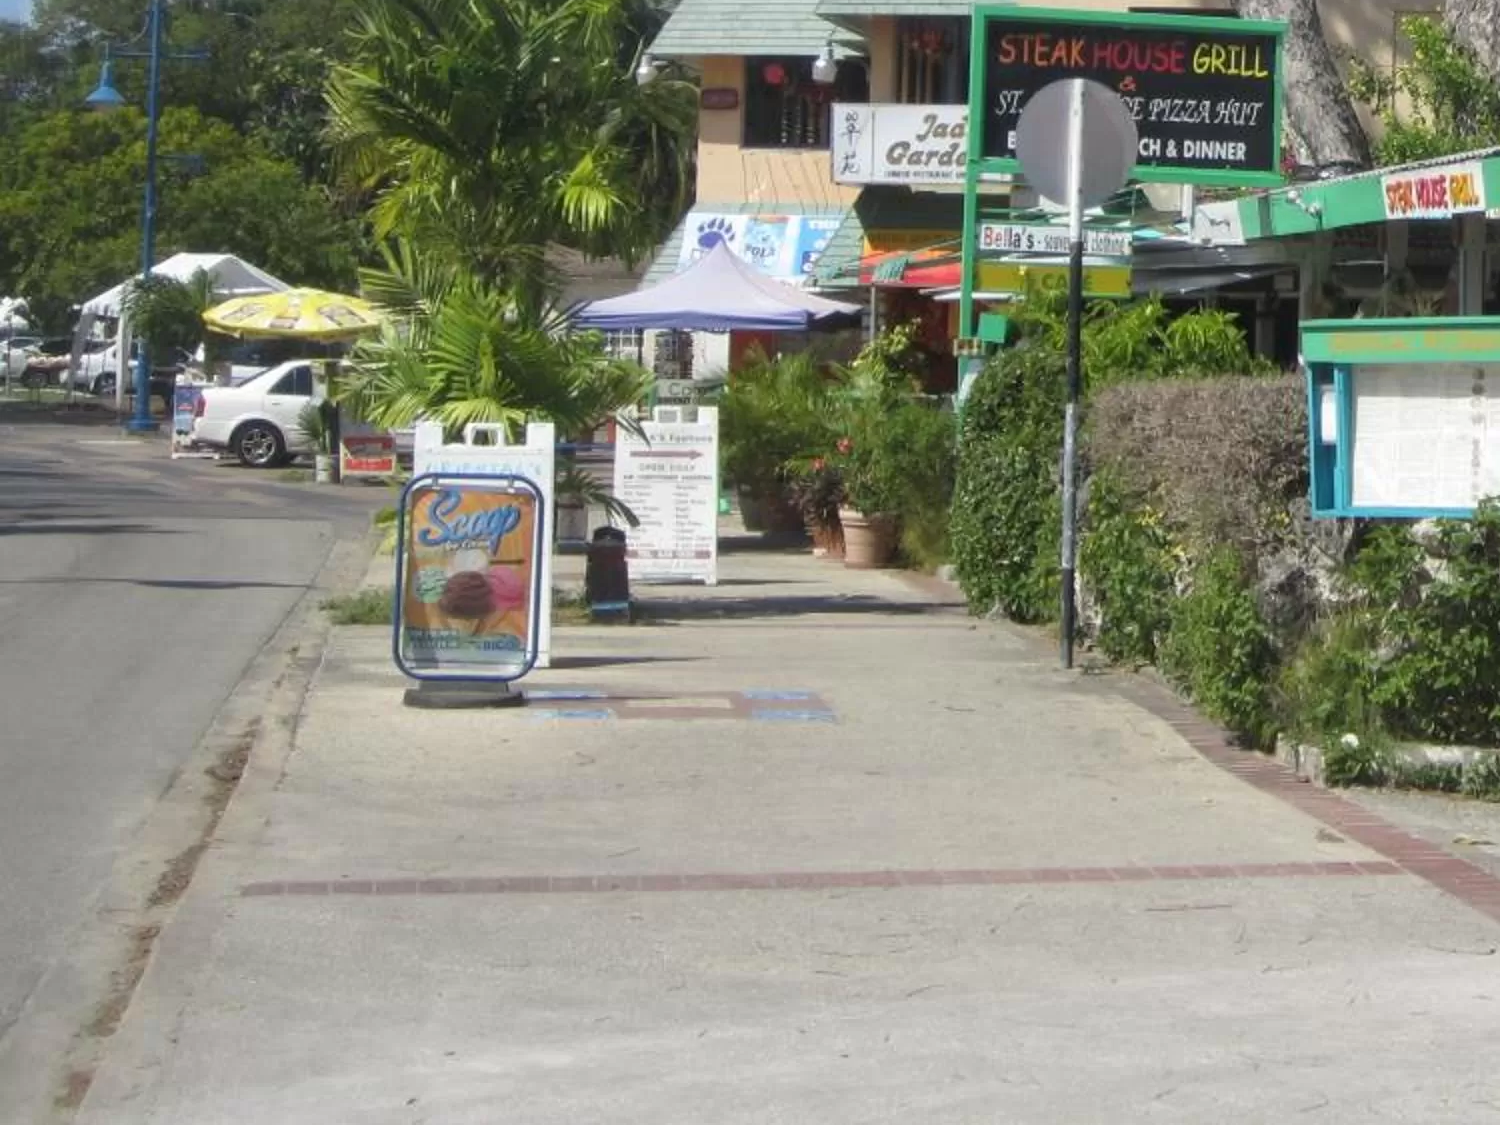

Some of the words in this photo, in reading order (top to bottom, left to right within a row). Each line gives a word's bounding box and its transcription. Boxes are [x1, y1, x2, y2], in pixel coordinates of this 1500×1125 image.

[999, 34, 1086, 67] STEAK
[1093, 39, 1185, 73] HOUSE
[1192, 43, 1269, 78] GRILL
[1120, 76, 1136, 91] &
[1149, 97, 1211, 123] PIZZA
[1213, 99, 1264, 126] HUT
[915, 113, 968, 142] Jad
[885, 141, 967, 166] Garde
[1165, 140, 1180, 158] &
[1183, 140, 1246, 160] DINNER
[984, 226, 1034, 249] Bella's
[418, 487, 521, 556] Scoop
